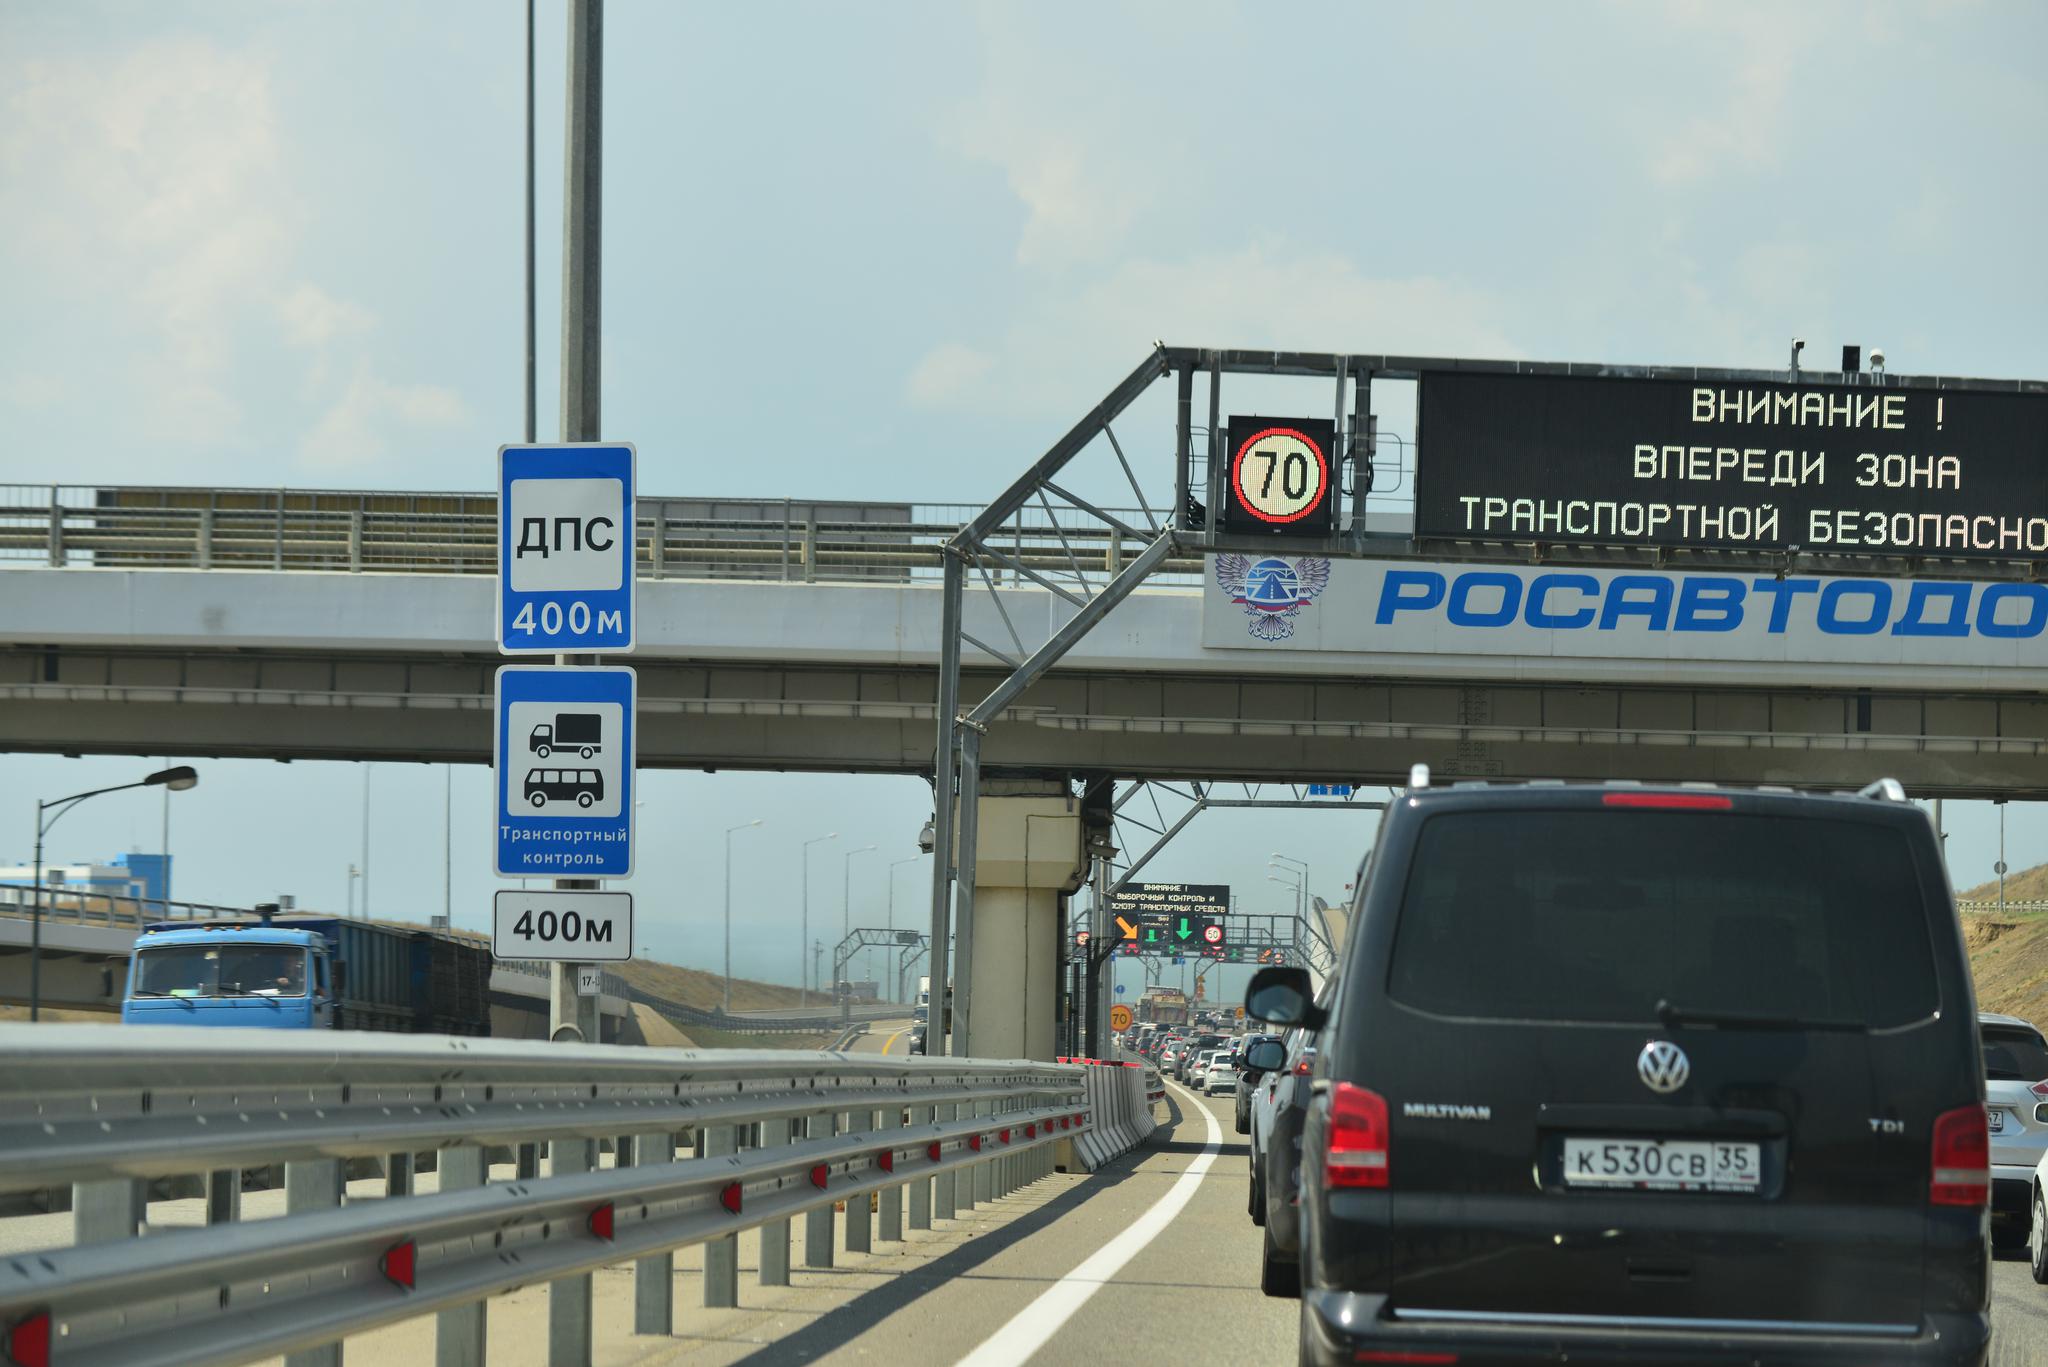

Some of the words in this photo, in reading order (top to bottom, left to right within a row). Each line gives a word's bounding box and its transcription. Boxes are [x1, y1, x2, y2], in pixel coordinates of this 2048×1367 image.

[1692, 388, 1906, 430] ВНИМАНИЕ
[1936, 397, 1943, 431] !
[1254, 451, 1308, 500] 70
[1634, 445, 1825, 487] ВПЕРЕДИ
[1855, 453, 1961, 490] ЗОНА
[1460, 496, 1778, 542] ТРАНСПОРТНОЙ
[1808, 510, 2048, 552] БЕЗОПАСНО
[516, 517, 614, 559] ДПС
[1376, 569, 2048, 638] РОСАВТОДО
[512, 602, 623, 635] 400м
[501, 826, 626, 844] Транспортный
[523, 853, 604, 867] контроль
[1140, 903, 1191, 912] ТРАНСПОРТНЫХ
[1194, 904, 1225, 913] СРЕДСТВ
[1168, 894, 1205, 903] КОНТРОЛЬ
[513, 911, 613, 942] 400м
[1208, 930, 1219, 940] 50
[1112, 1013, 1127, 1024] 70
[1869, 1118, 1905, 1133] TDI
[1718, 1146, 1749, 1170] 35
